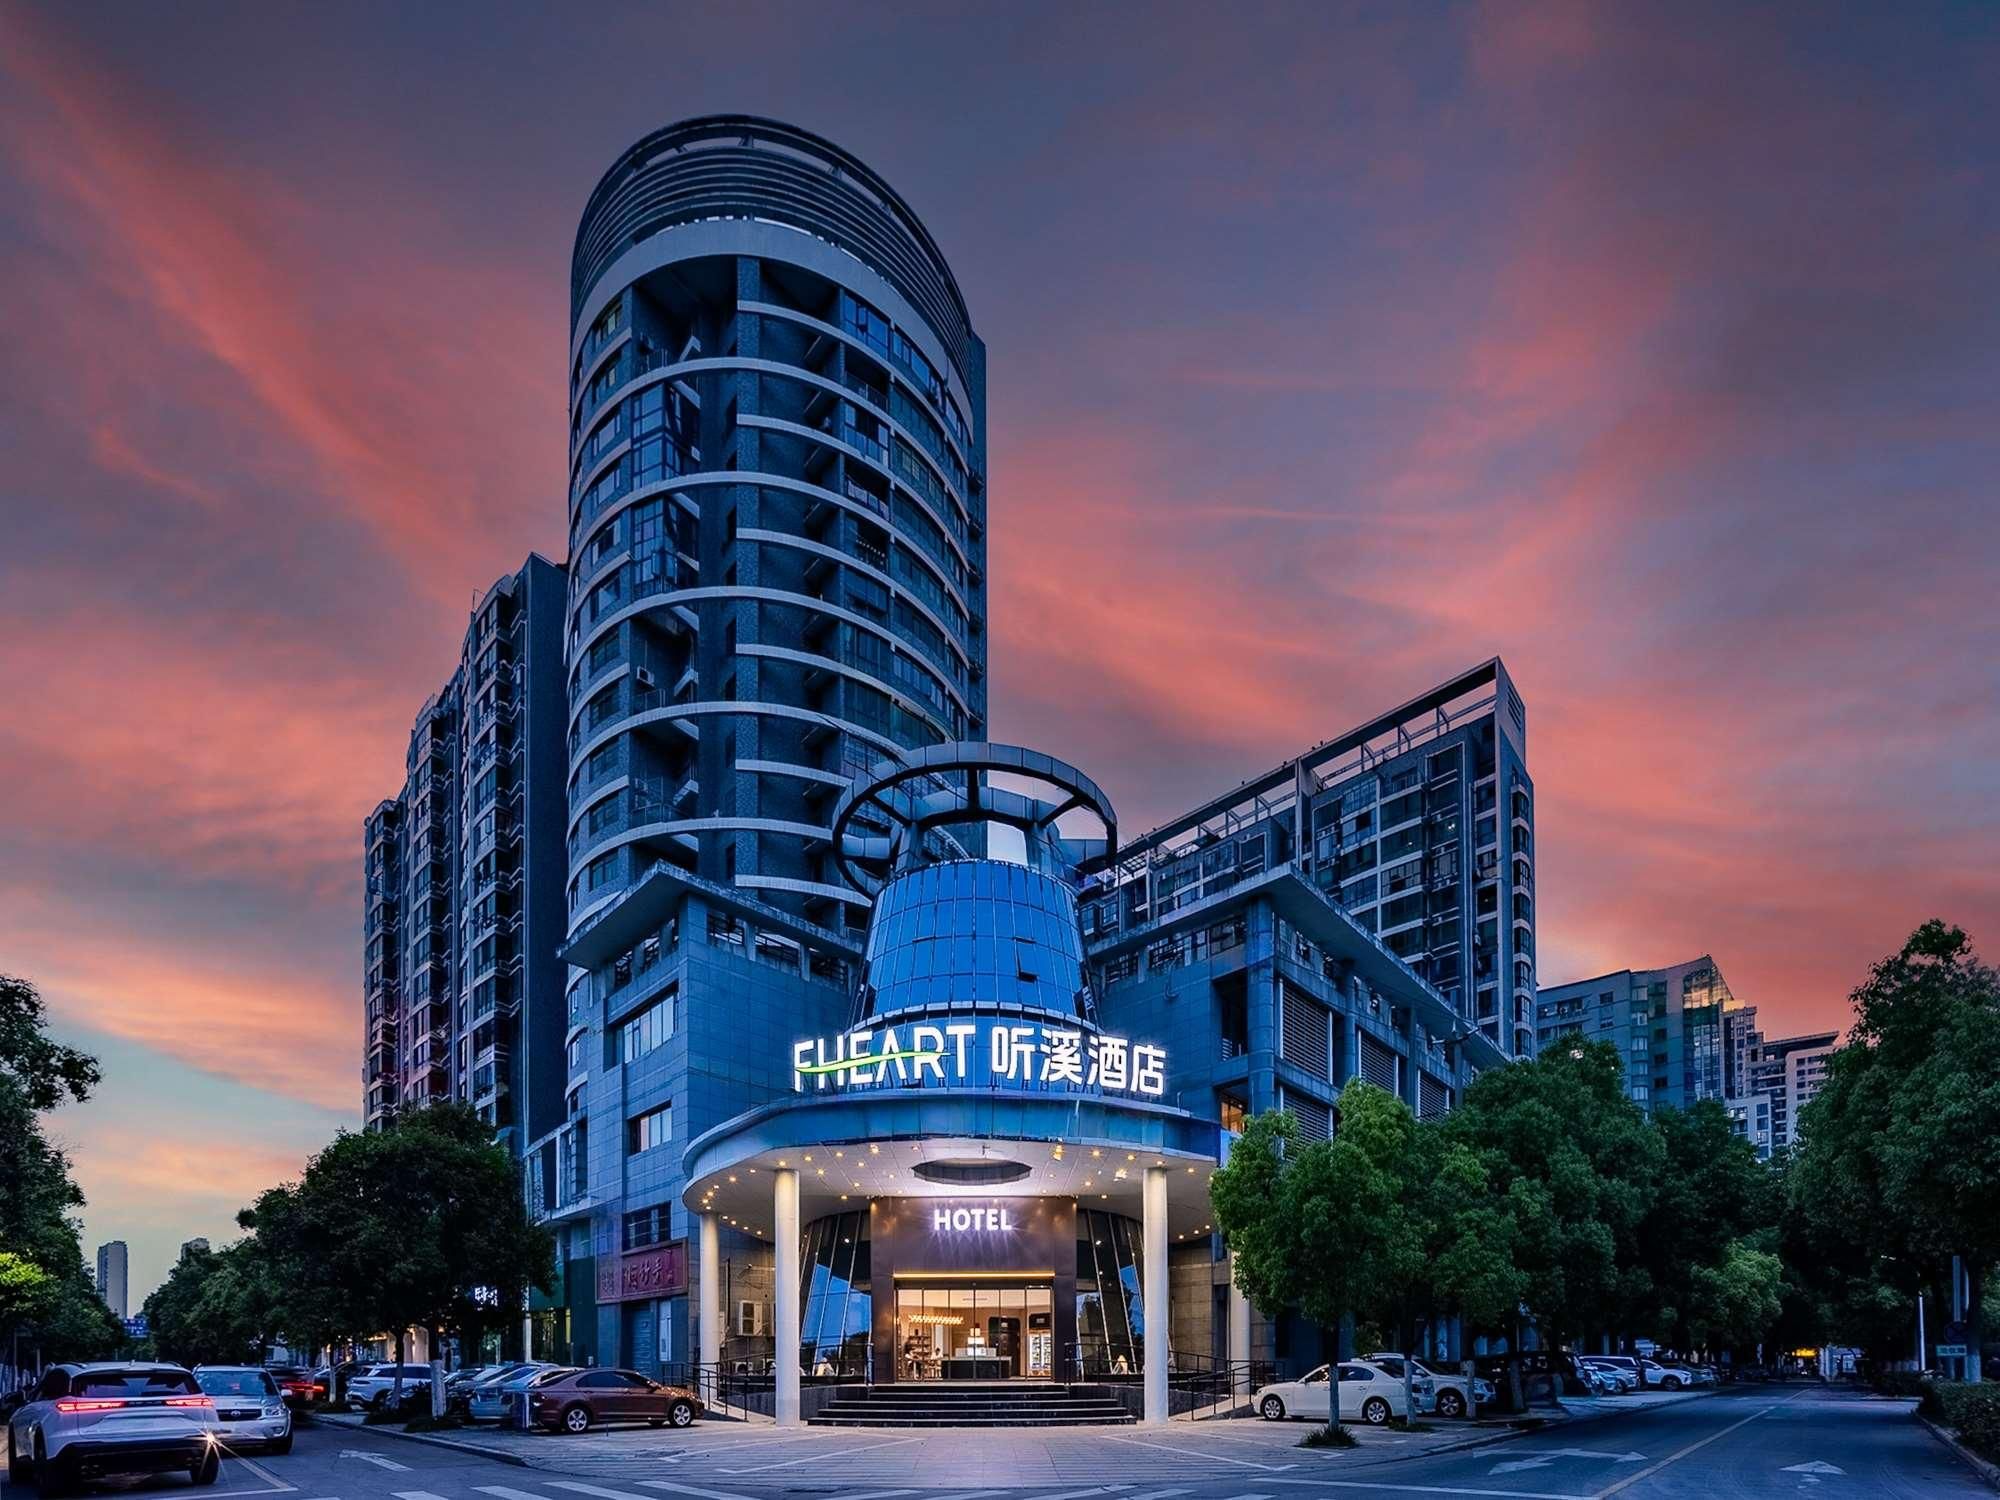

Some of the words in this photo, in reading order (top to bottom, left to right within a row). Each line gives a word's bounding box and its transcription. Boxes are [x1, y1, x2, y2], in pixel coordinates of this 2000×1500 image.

[794, 1024, 976, 1092] FHEART
[991, 1025, 1167, 1096] 听溪酒店
[933, 1208, 1013, 1232] HOTEL
